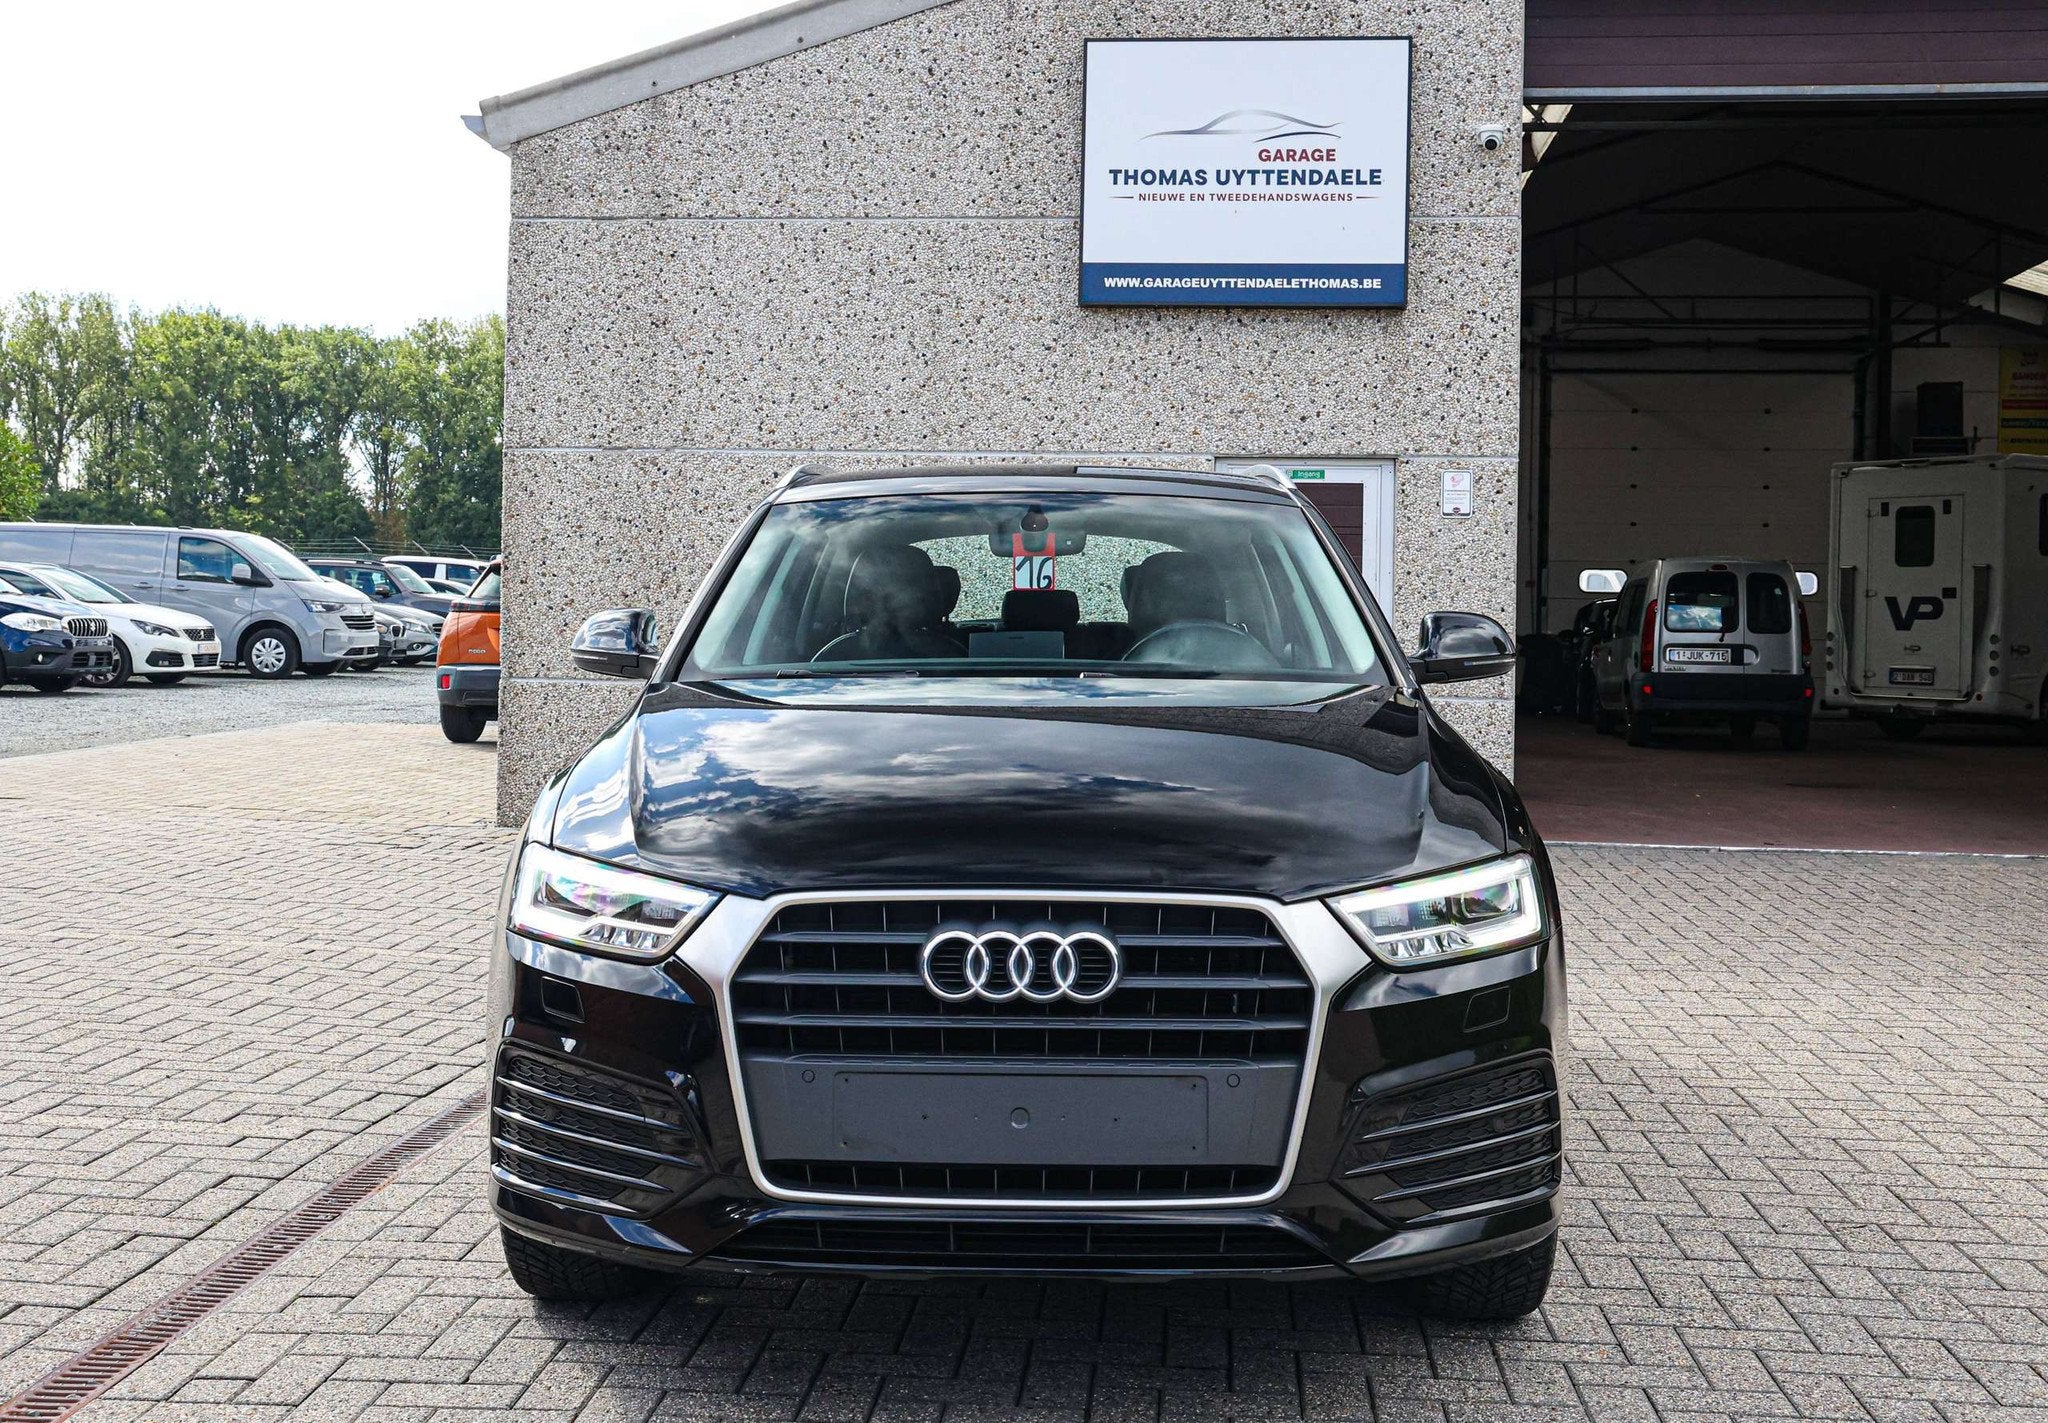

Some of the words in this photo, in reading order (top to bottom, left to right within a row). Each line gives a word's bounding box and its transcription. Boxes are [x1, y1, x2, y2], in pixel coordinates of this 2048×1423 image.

[1258, 148, 1336, 162] GARAGE
[1109, 168, 1208, 186] THOMAS
[1215, 168, 1382, 186] UYTTENDAELE
[1138, 192, 1186, 202] NIEUWE
[1190, 193, 1204, 202] EN
[1209, 193, 1353, 202] TWEEDEHANDSWAGENS
[1104, 277, 1382, 289] WWW.GARAGEUYTTENDAELETHOMAS.BE
[1015, 556, 1052, 589] 16
[1884, 596, 1944, 631] VP
